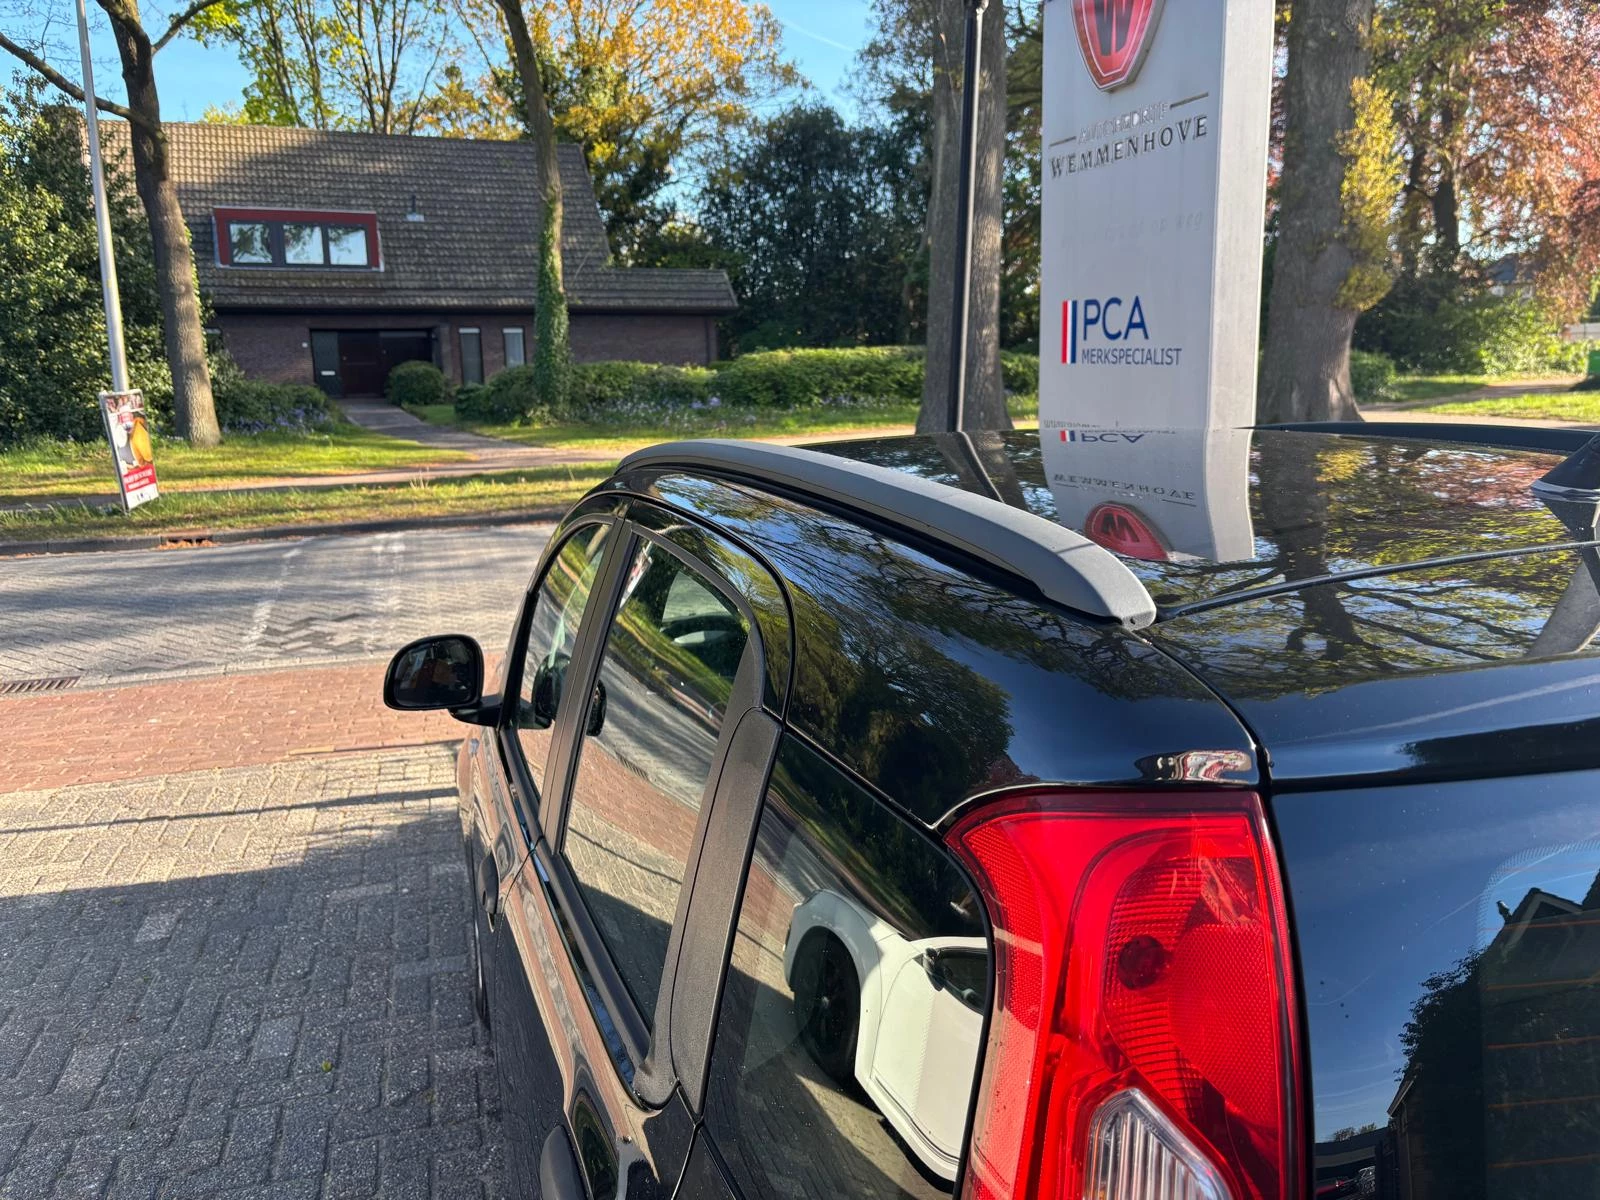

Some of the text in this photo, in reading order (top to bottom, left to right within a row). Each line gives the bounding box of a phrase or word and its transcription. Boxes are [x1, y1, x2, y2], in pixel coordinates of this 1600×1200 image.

[1050, 116, 1208, 179] WEMMENHOVE
[1083, 295, 1149, 341] PCA
[1081, 348, 1182, 365] MERKSPECIALIST
